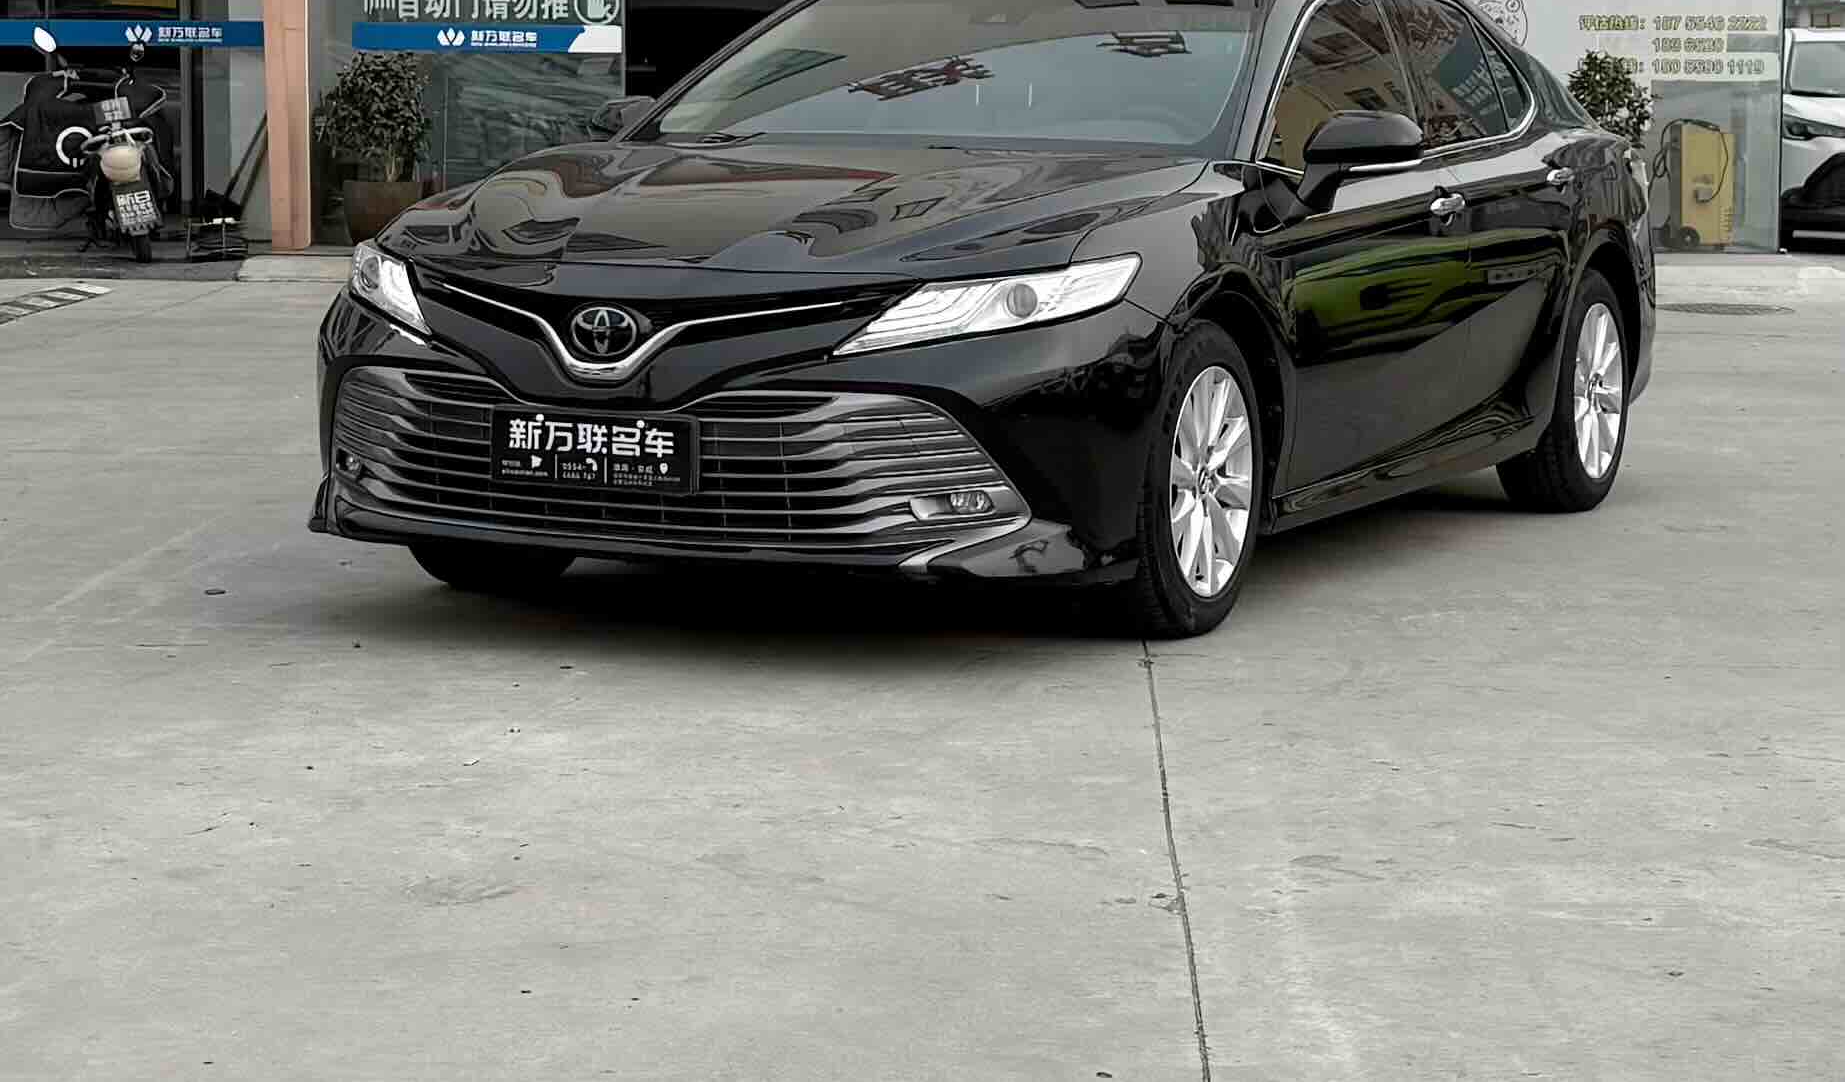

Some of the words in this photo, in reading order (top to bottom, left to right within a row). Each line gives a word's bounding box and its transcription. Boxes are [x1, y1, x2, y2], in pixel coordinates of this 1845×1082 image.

[508, 418, 675, 458] 新万联名车
